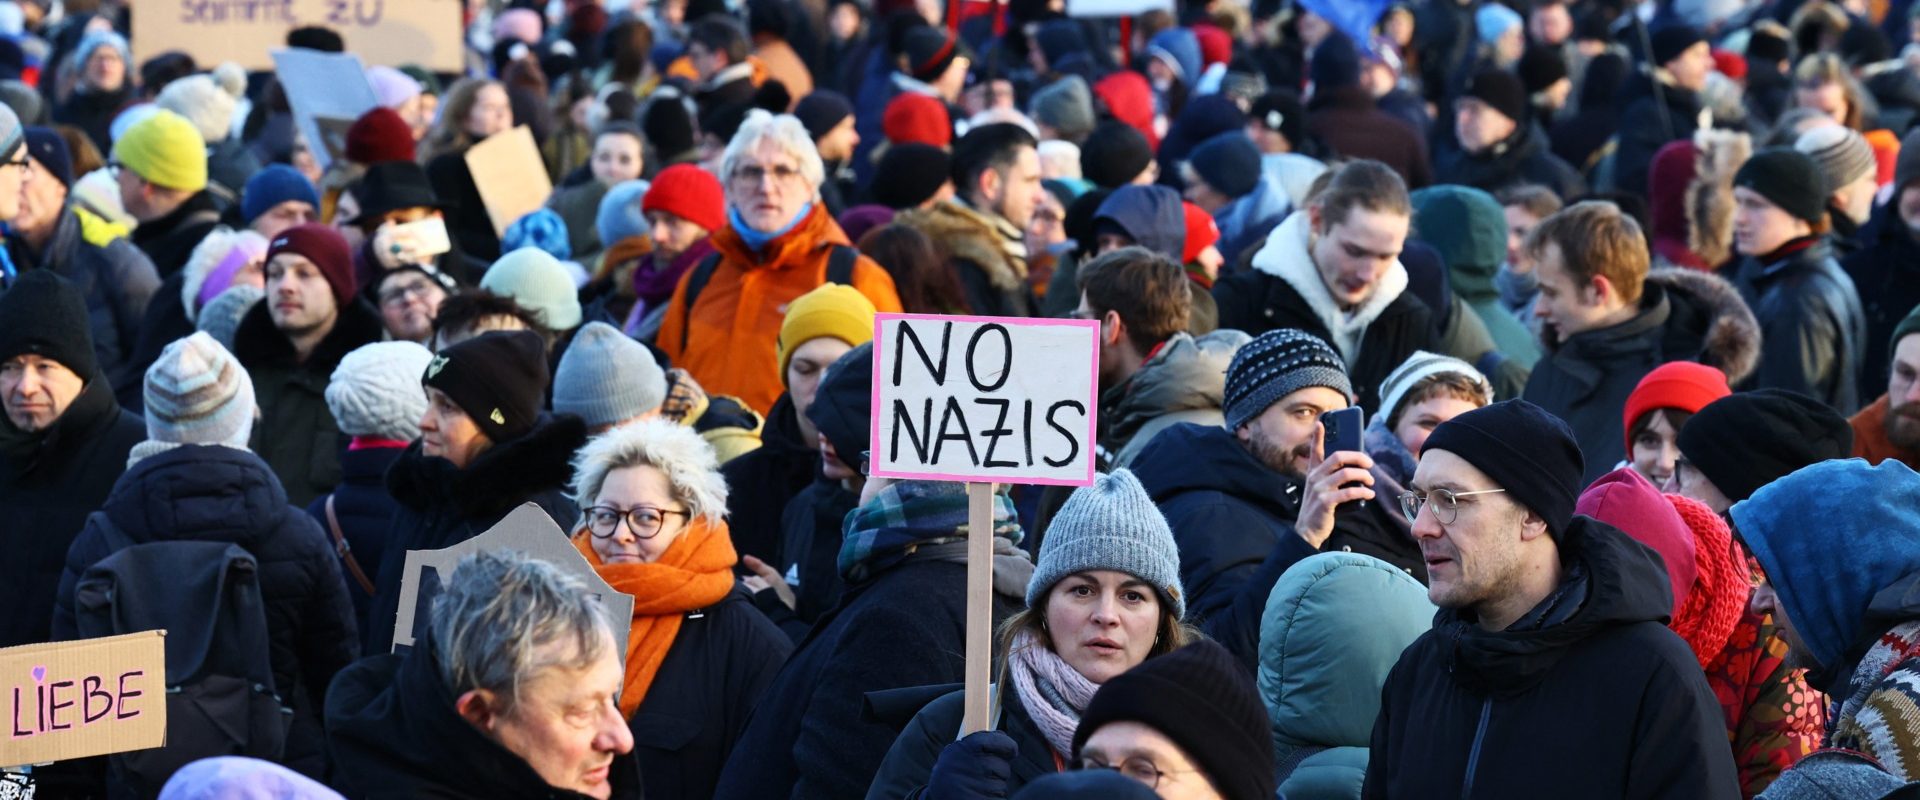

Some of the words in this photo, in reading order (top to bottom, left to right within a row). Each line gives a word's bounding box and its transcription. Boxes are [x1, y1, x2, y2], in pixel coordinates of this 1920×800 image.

[893, 320, 1013, 392] NO
[890, 395, 1086, 468] NAZIS
[12, 669, 144, 738] LIEBE
